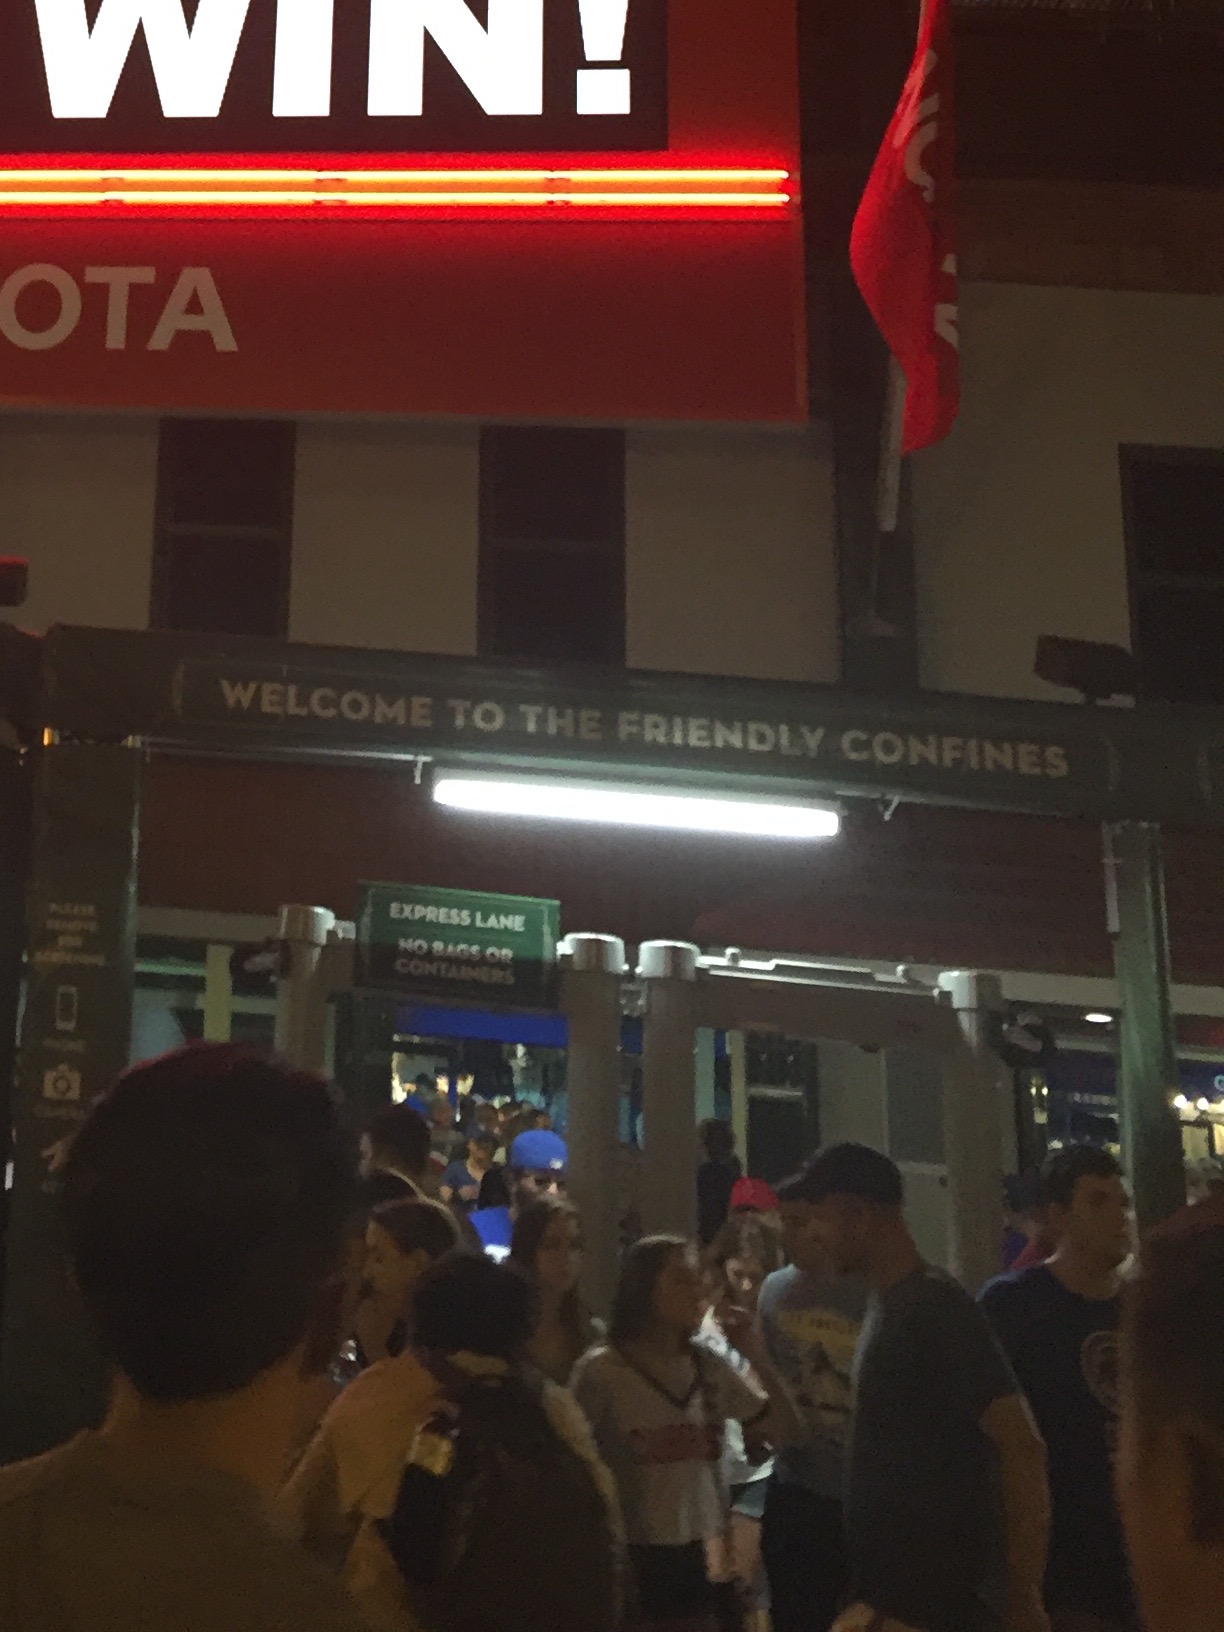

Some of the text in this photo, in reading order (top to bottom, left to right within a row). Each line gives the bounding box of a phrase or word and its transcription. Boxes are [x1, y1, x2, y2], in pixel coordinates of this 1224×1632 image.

[219, 678, 1071, 779] WELCOME TO THE FRIENDLY CONFINES
[389, 900, 527, 932] EXPRESS LANE
[397, 937, 515, 965] NO BAGS OR
[393, 957, 516, 986] CONTAINERS
